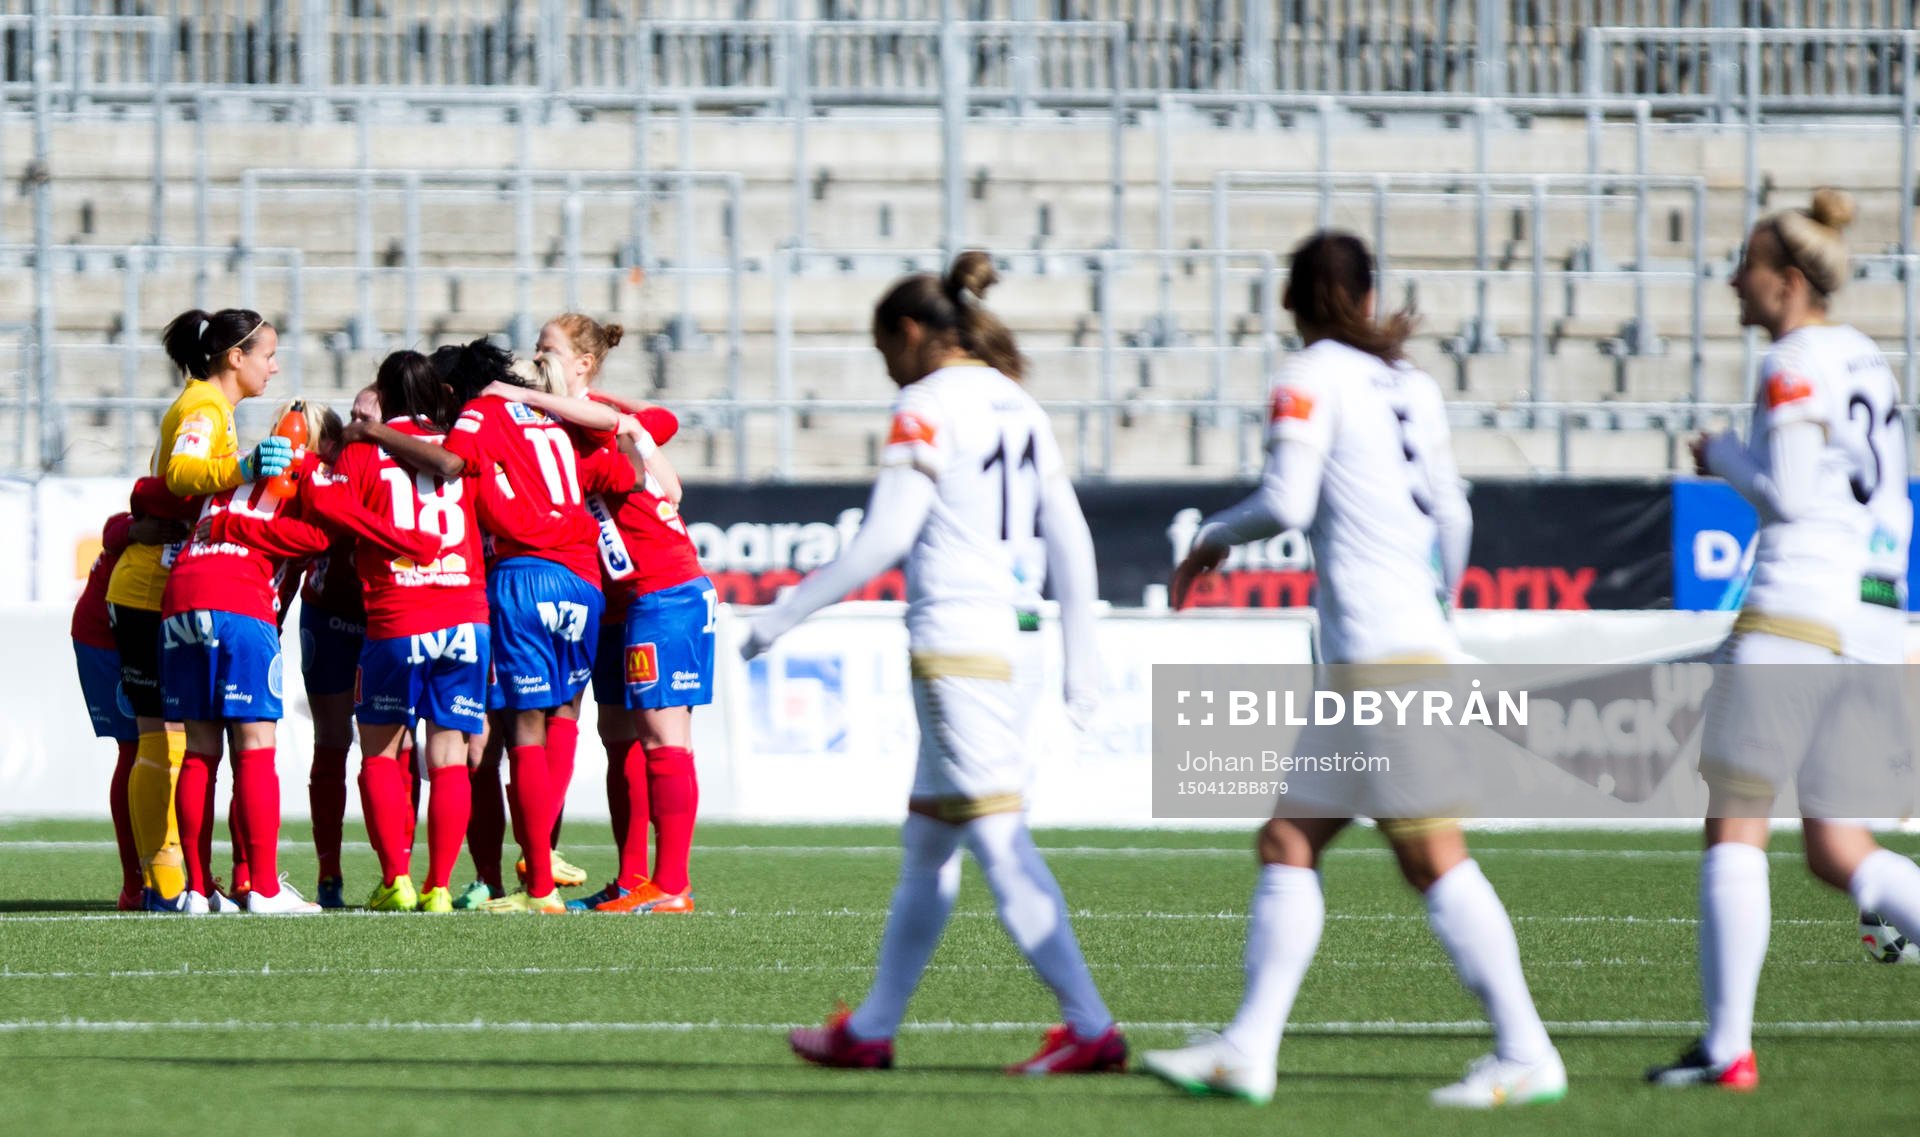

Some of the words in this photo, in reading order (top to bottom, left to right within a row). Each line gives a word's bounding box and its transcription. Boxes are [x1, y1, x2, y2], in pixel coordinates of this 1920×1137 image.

[523, 427, 581, 505] 11
[979, 424, 1042, 541] 11
[379, 466, 466, 549] 18
[684, 507, 864, 574] ograf
[407, 622, 478, 664] NA
[536, 600, 588, 642] NA
[1652, 662, 1714, 712] UP
[1527, 697, 1683, 757] BACK
